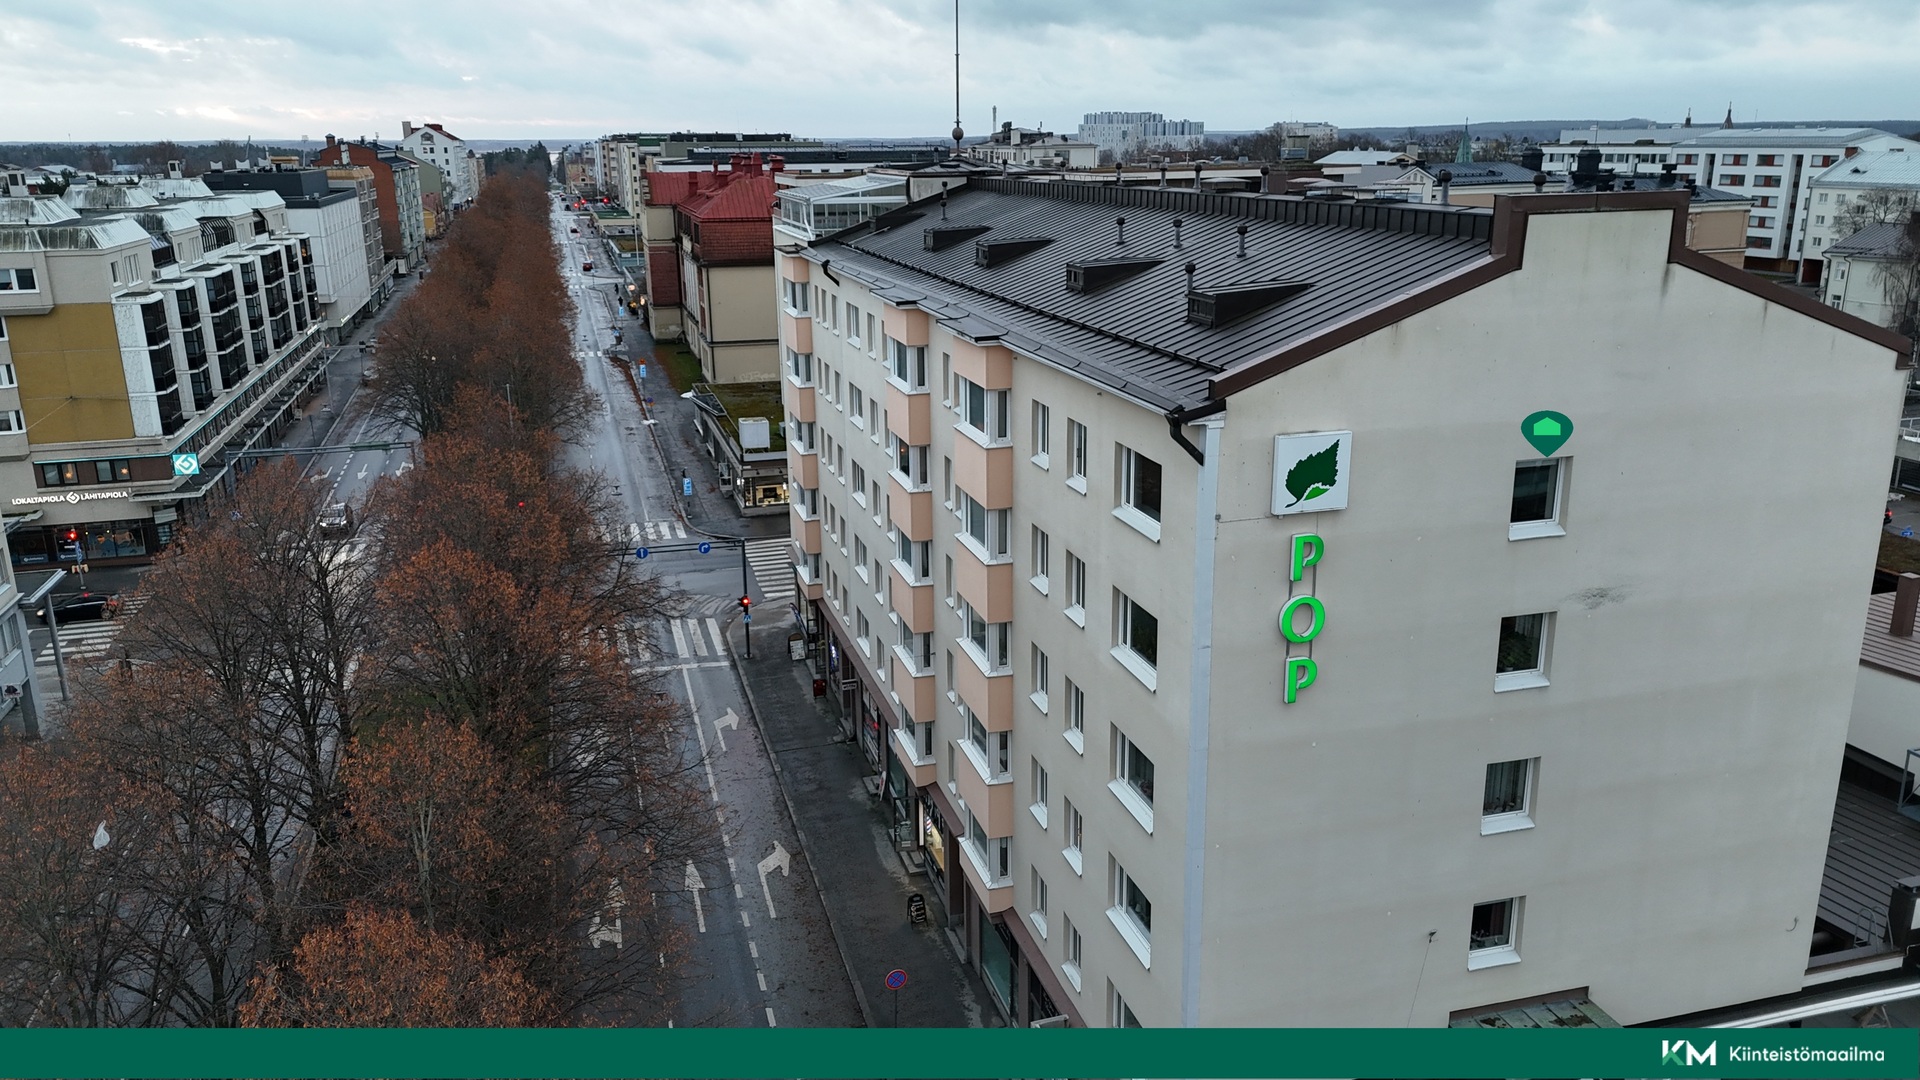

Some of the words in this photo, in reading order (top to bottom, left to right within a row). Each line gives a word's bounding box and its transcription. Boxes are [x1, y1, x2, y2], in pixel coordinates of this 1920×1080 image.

[11, 496, 66, 505] LOKALTAPIOLA
[80, 491, 128, 501] LÄHITAPIOLA
[1278, 533, 1326, 704] POP
